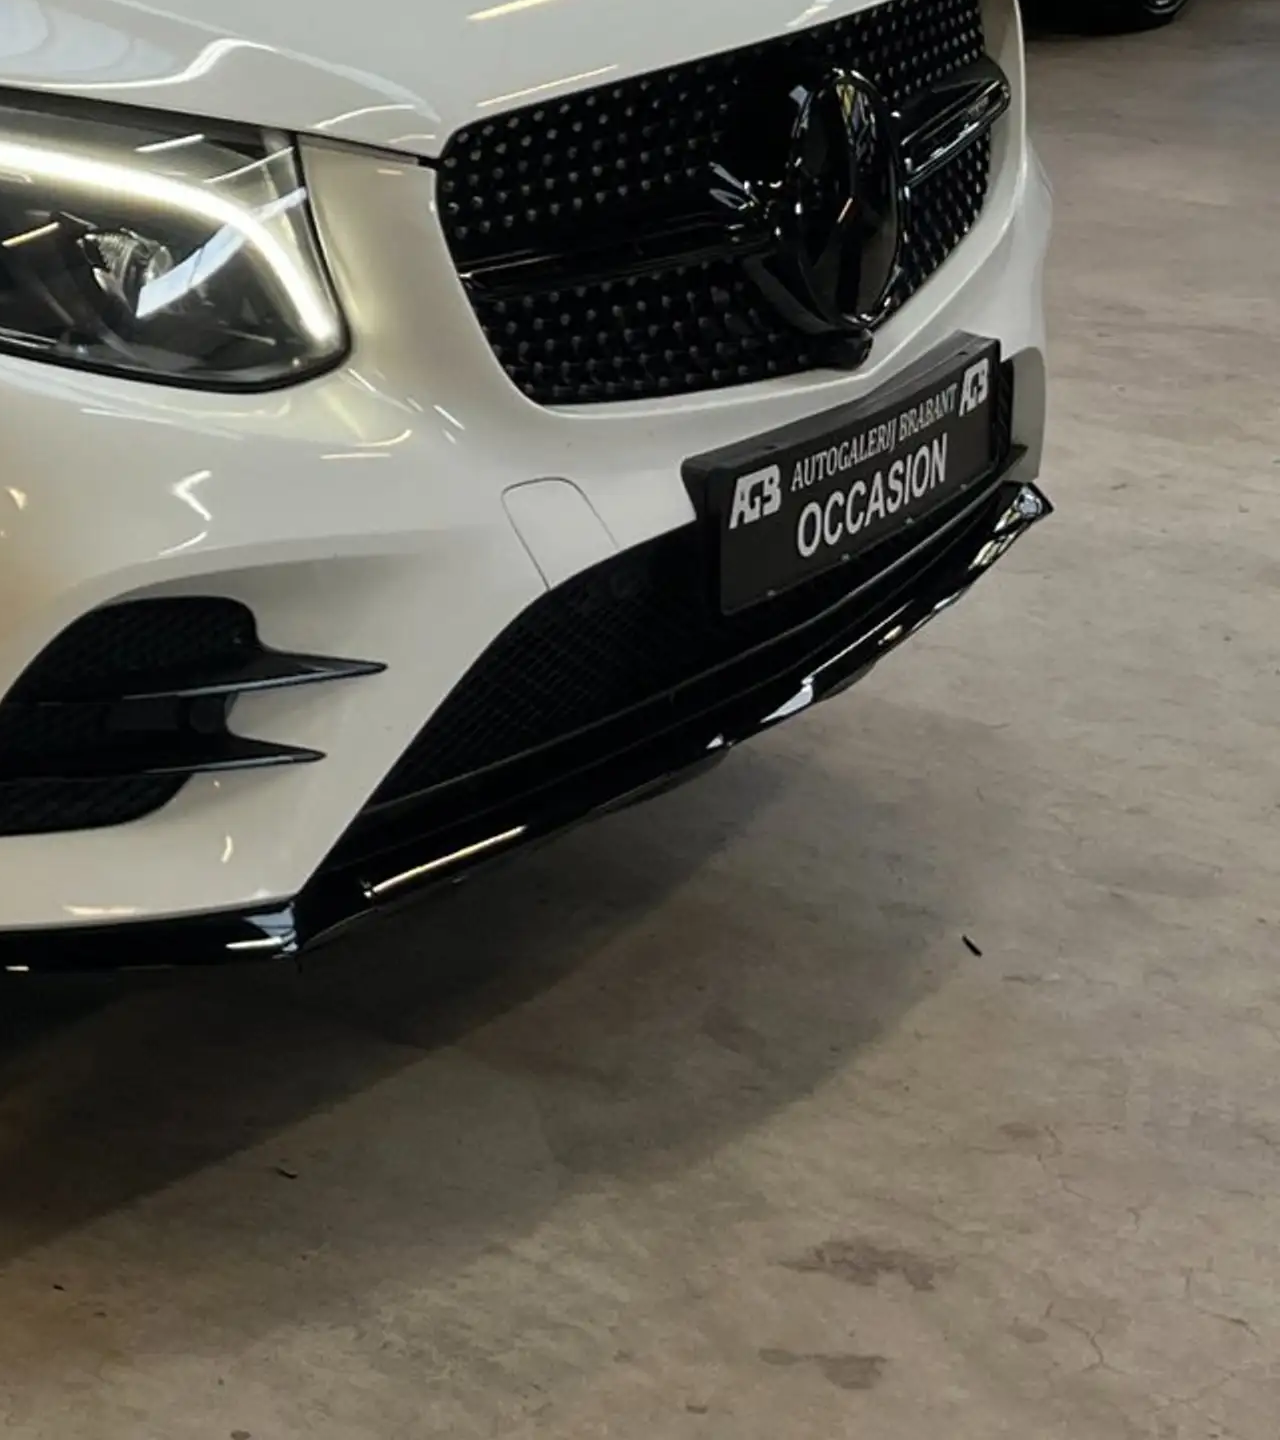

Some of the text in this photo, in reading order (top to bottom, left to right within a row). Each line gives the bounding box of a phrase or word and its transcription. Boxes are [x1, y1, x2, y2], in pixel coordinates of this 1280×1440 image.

[791, 383, 957, 492] AUTOGALERIJ BRABANT
[798, 433, 948, 558] OCCASION
